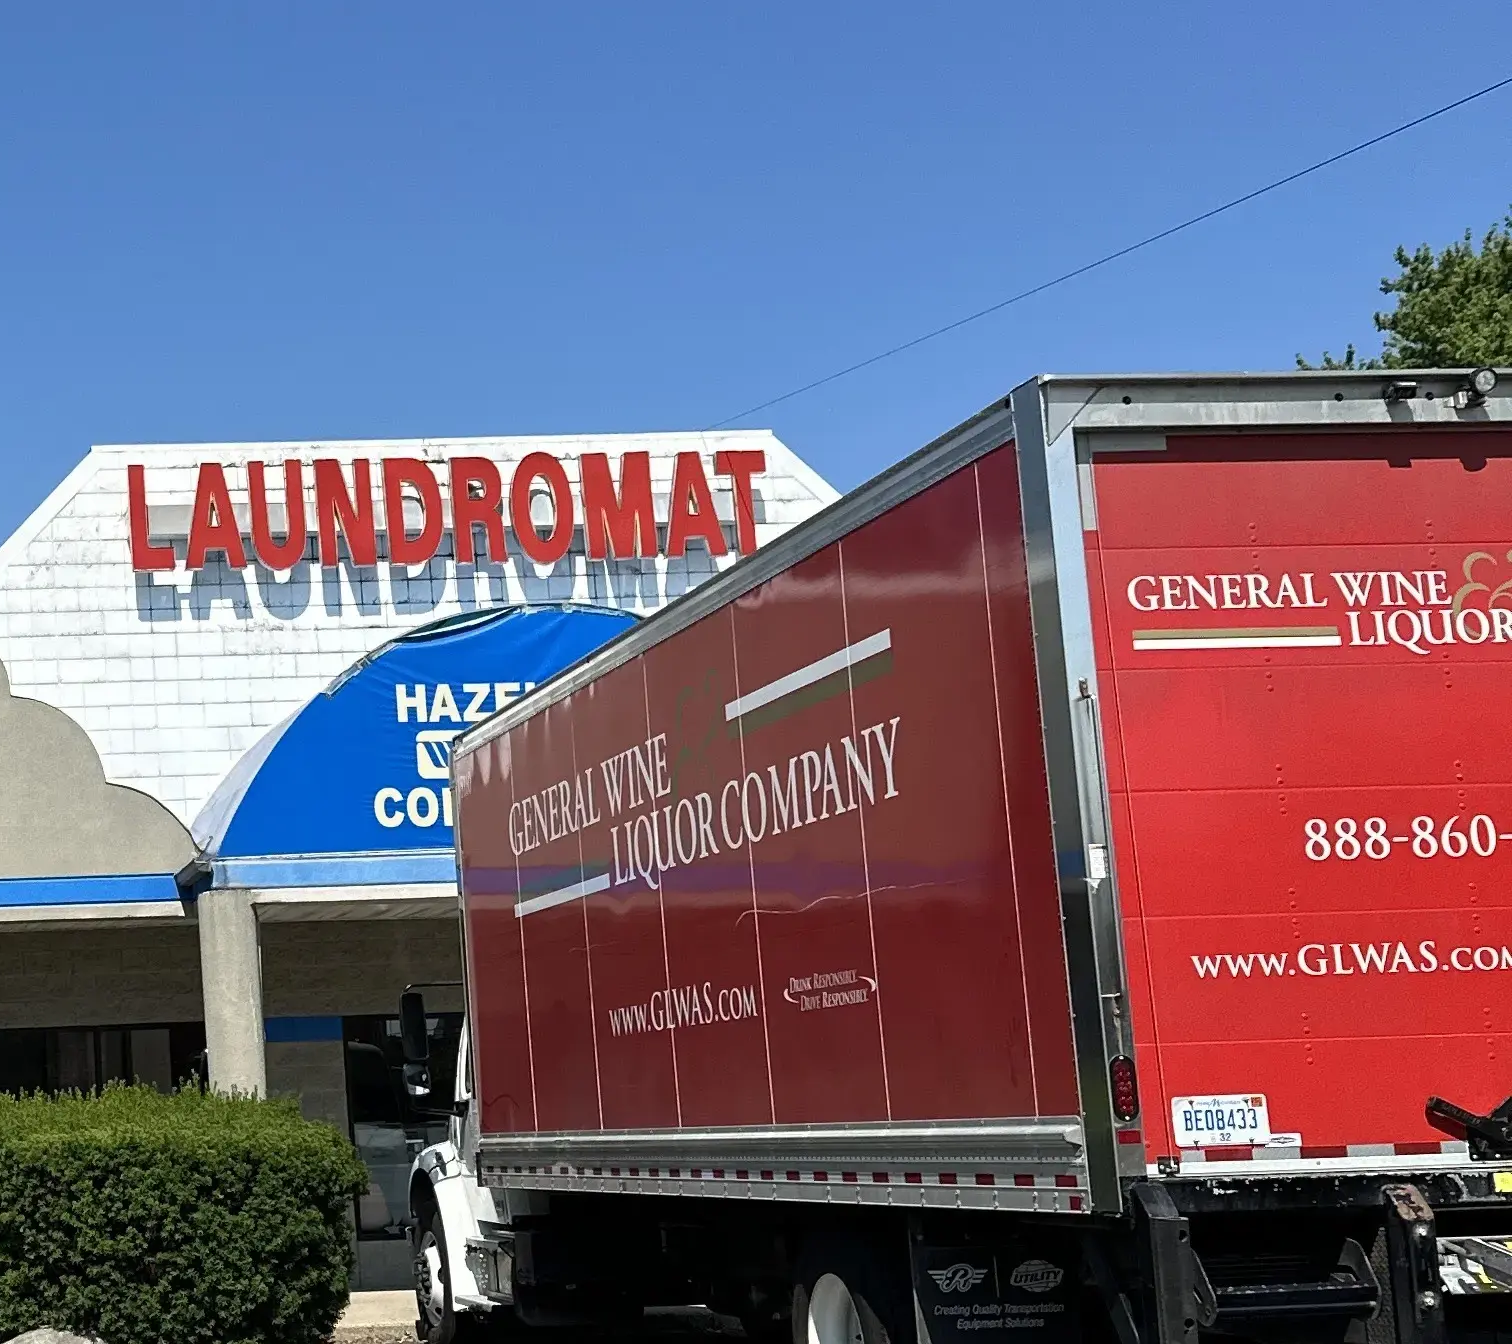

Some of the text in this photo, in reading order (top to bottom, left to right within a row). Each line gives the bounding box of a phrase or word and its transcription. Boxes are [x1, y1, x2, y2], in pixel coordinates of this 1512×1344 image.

[127, 450, 766, 573] LAUNDROMAT
[1126, 573, 1328, 611] GENERAL
[1330, 570, 1453, 607] WINE
[1345, 607, 1512, 655] LIQUOR
[395, 682, 535, 723] HAZE
[508, 732, 671, 856] GENERAL WINE
[610, 717, 901, 891] LIQUOR COMPANY
[1303, 814, 1512, 862] 888-860-
[1219, 1132, 1232, 1142] 32
[1013, 1270, 1061, 1284] UTILITY
[934, 1302, 1065, 1316] Creating Quality Transportation
[957, 1317, 1045, 1330] Equipment Solutions
